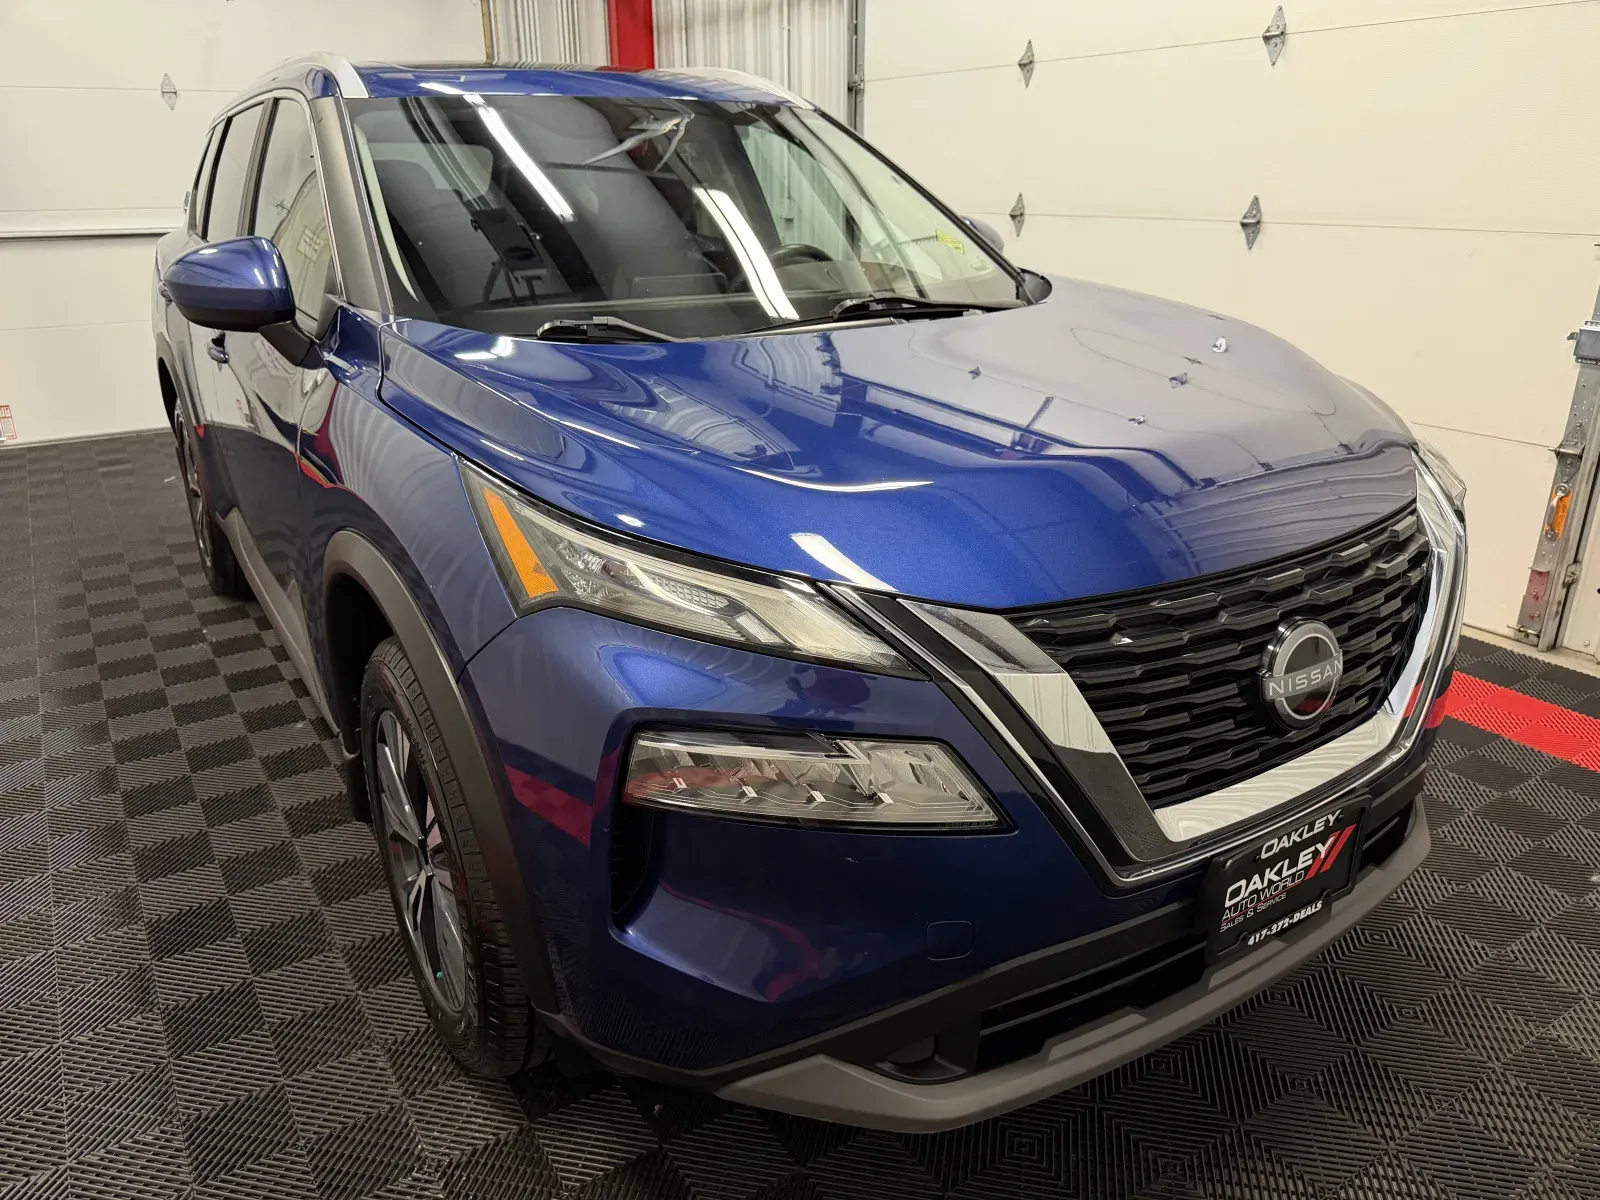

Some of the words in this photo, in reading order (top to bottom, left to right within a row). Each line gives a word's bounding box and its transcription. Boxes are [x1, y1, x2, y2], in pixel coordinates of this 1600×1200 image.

[1268, 659, 1343, 697] NISSAN
[1261, 809, 1342, 860] OAKLEY
[1224, 834, 1336, 908] OAKLEY
[1220, 914, 1244, 933] SALES
[1246, 908, 1254, 919] &
[1256, 893, 1287, 913] SERVICE
[1222, 894, 1257, 922] AUTO
[1259, 871, 1304, 902] WORLD
[1247, 900, 1323, 946] 417-272-DEALS
